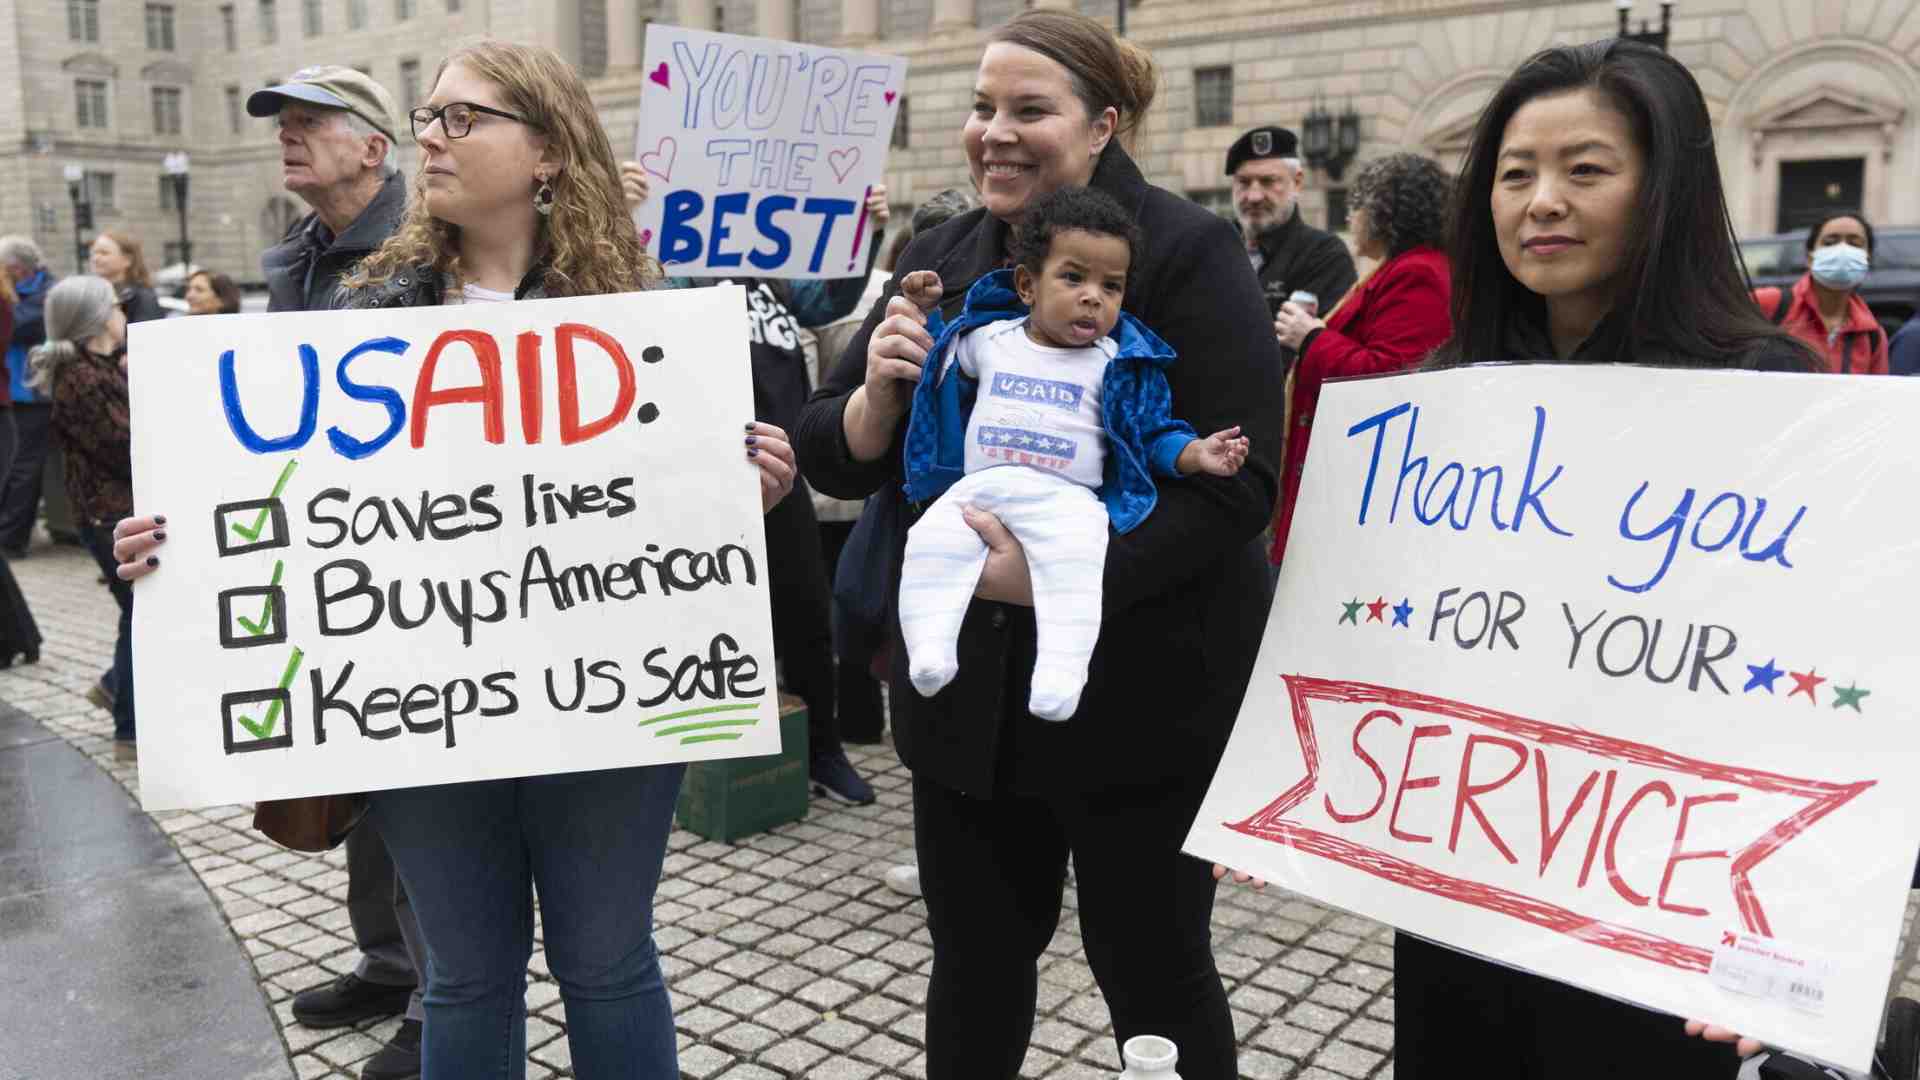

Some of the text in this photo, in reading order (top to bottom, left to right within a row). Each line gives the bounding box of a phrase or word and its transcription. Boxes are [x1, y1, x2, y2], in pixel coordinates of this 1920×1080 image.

[705, 138, 819, 192] THE
[658, 185, 873, 273] BEST!
[219, 324, 664, 460] USAID:
[999, 378, 1076, 403] USAID
[307, 474, 636, 549] Saves lives
[1347, 402, 1807, 593] Thank you
[314, 544, 756, 647] Buys American
[1429, 587, 1737, 695] FOR YOUR
[310, 660, 518, 748] Keeps
[1324, 710, 1739, 917] SERVICE
